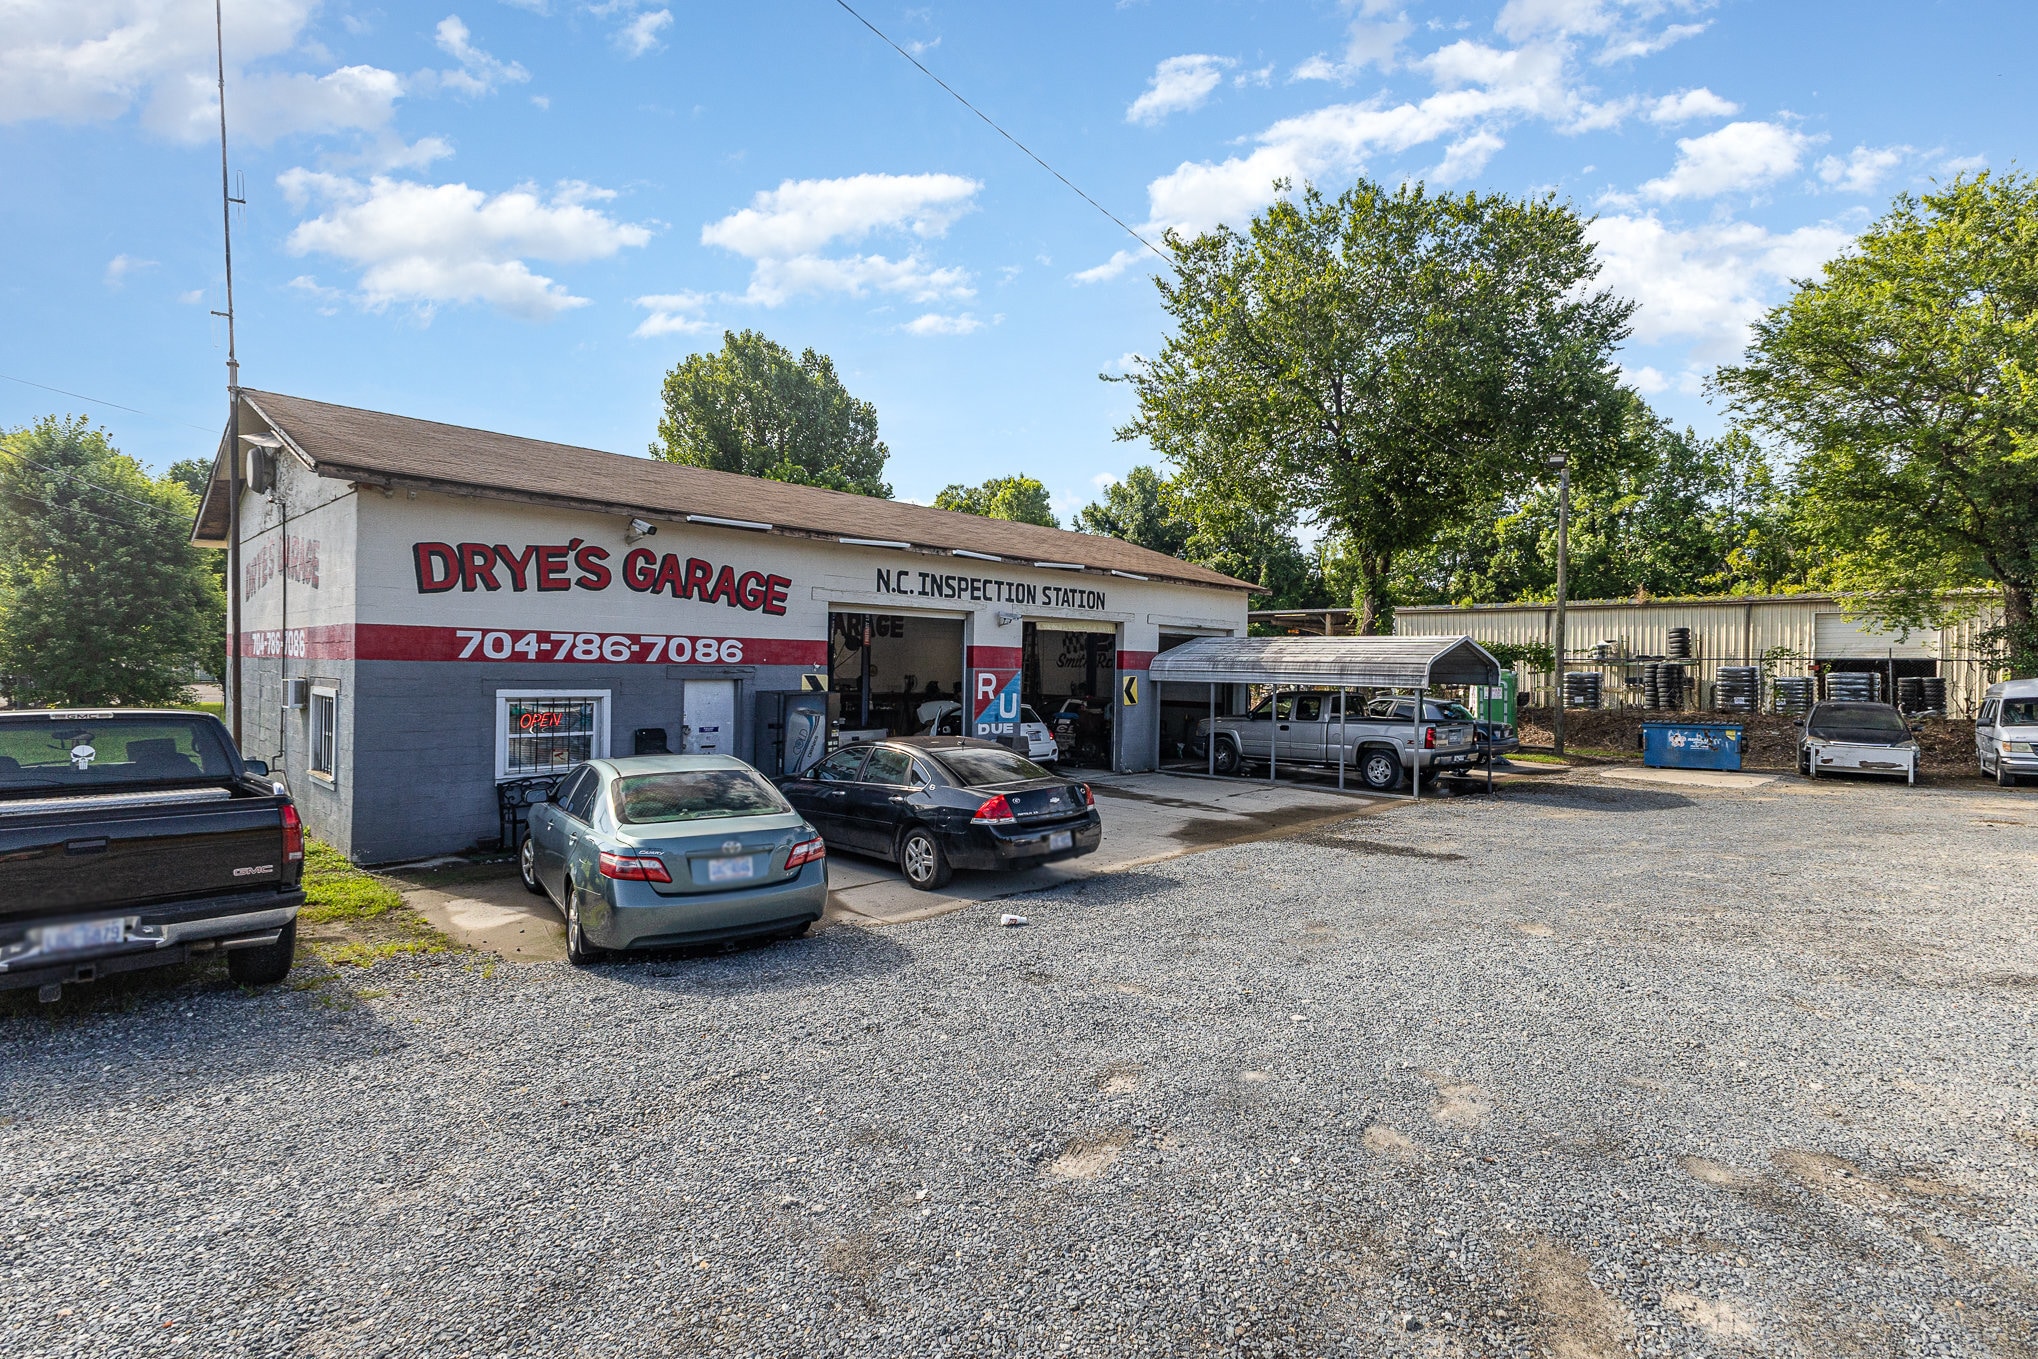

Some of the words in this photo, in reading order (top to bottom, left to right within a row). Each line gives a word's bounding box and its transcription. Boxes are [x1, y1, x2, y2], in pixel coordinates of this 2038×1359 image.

[412, 538, 612, 594] DRYE'S
[622, 548, 792, 616] GARAGE
[876, 568, 914, 595] N.C.
[918, 572, 1036, 605] INSPECTION
[1042, 586, 1106, 610] STATION
[456, 630, 743, 662] 704-786-7086
[977, 673, 997, 700] R
[1000, 693, 1017, 718] U
[520, 713, 562, 728] OPEN
[977, 723, 1013, 735] DUE
[233, 865, 273, 876] GMC
